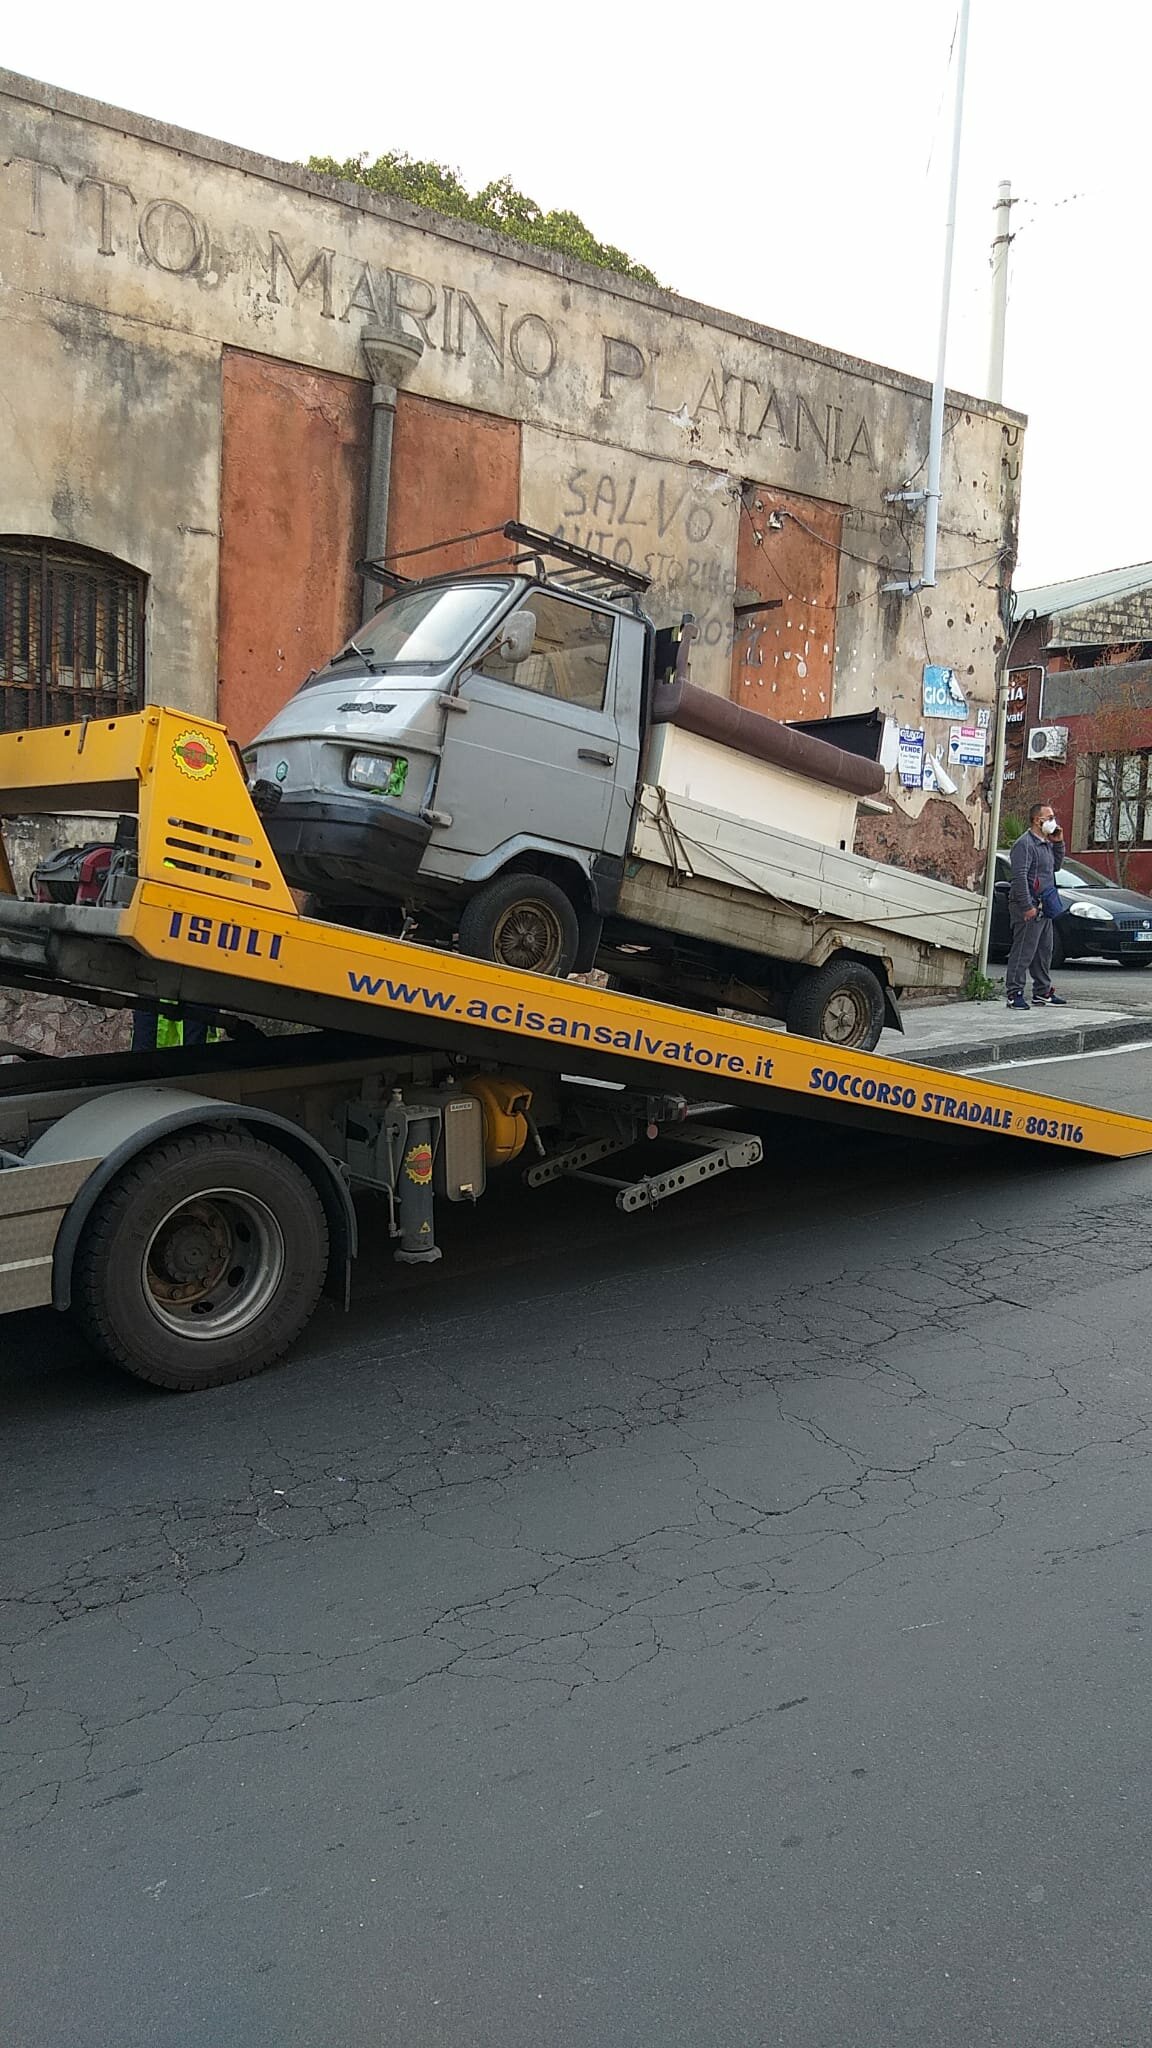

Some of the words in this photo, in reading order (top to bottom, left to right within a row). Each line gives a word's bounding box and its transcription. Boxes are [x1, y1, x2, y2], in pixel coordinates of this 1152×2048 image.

[265, 229, 558, 380] MARINO
[599, 335, 879, 473] PLATANIA
[564, 466, 714, 543] SALVO
[900, 745, 921, 754] VENDE
[168, 911, 283, 961] ISOLI
[347, 971, 775, 1080] www.acisansalvatore.it
[808, 1067, 916, 1109] SOCCORSO
[920, 1092, 1013, 1130] STRADALE
[1025, 1116, 1084, 1144] 803.116
